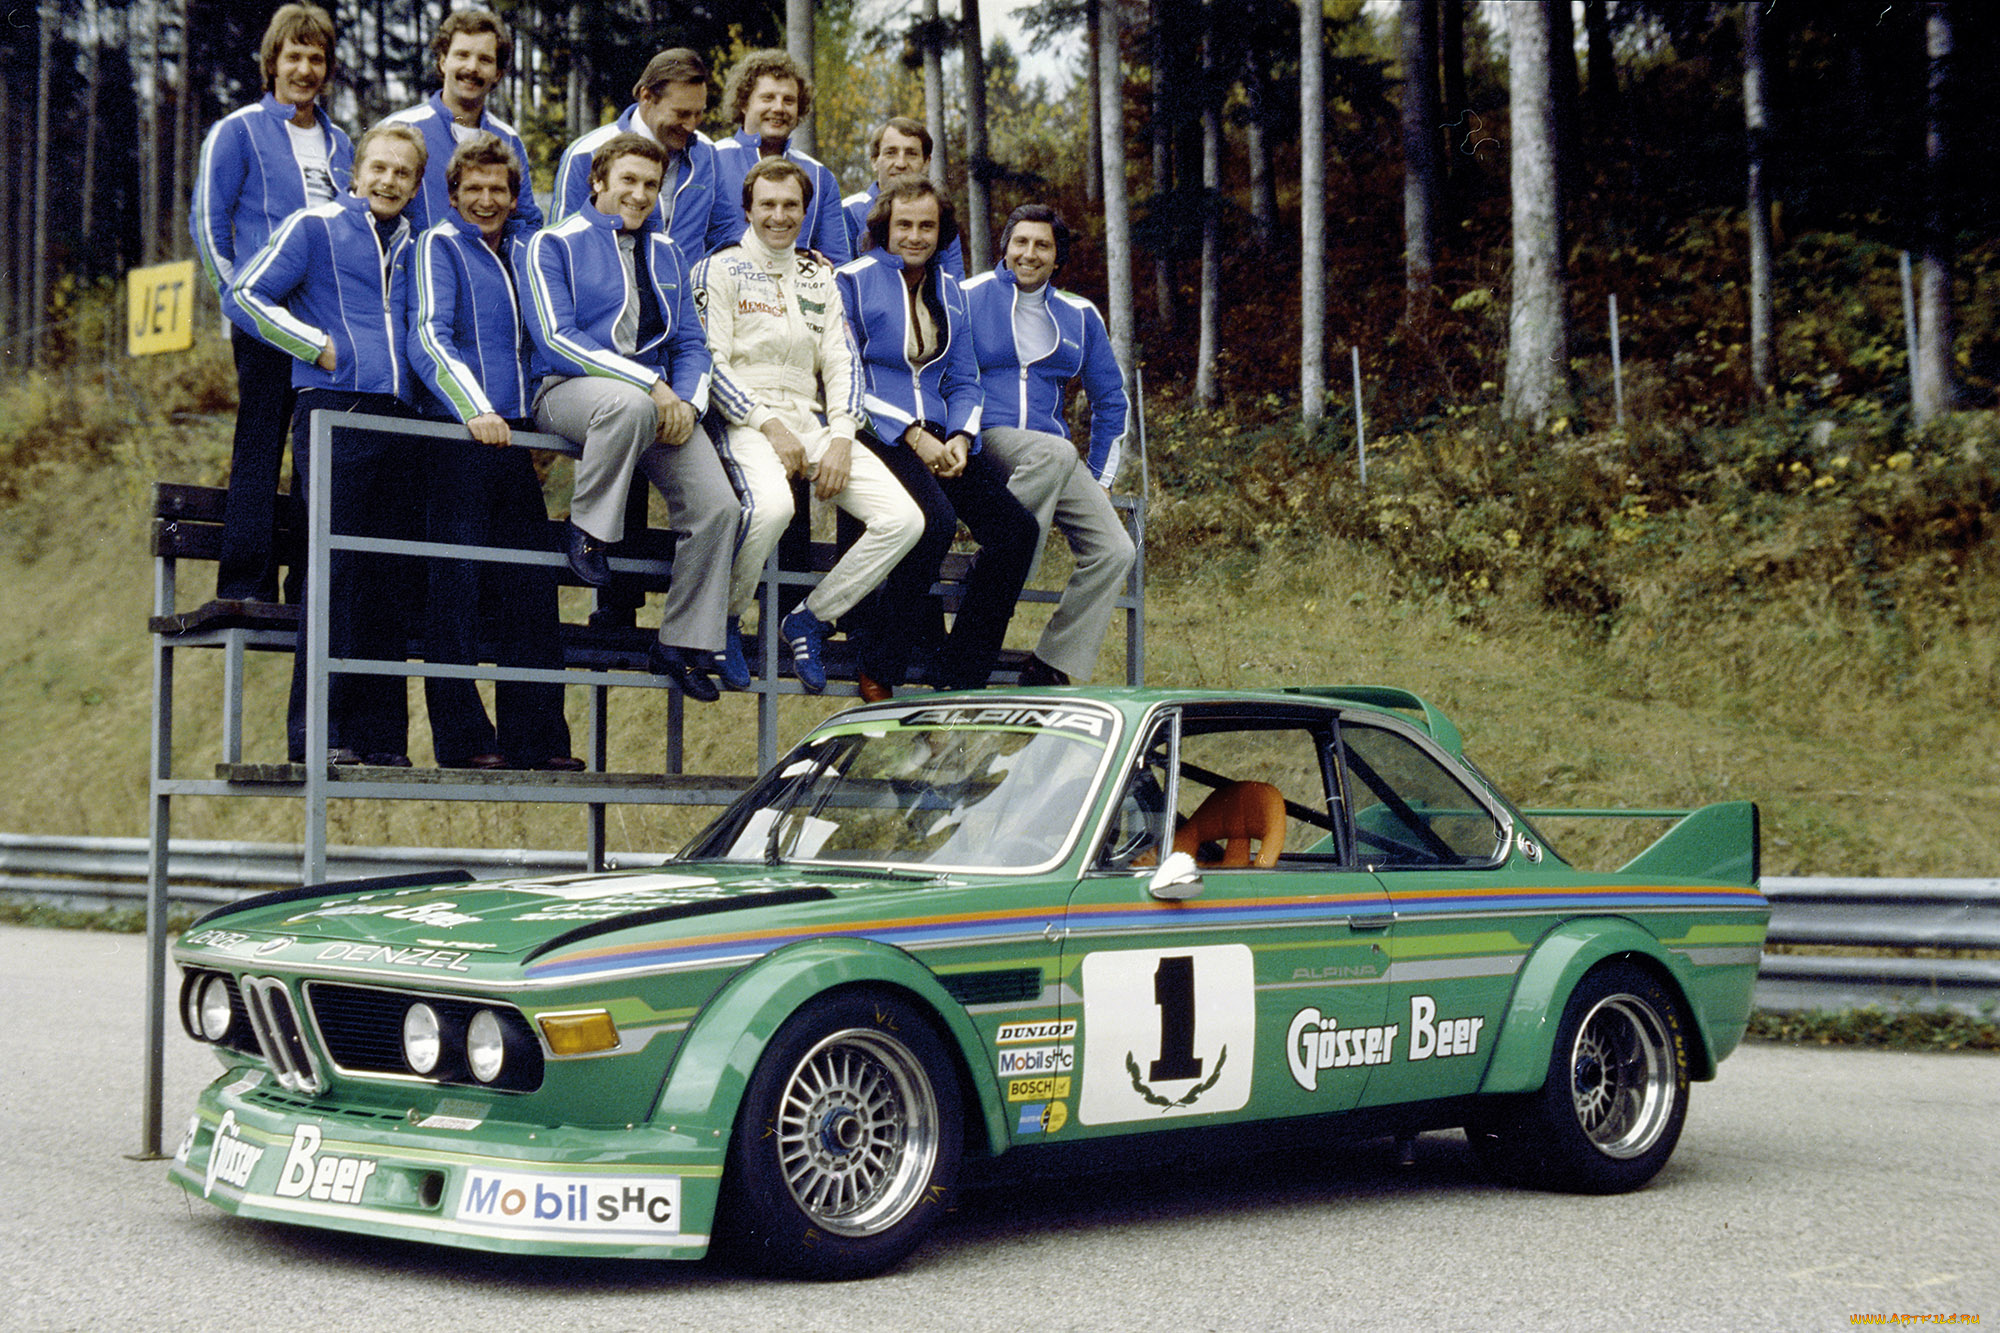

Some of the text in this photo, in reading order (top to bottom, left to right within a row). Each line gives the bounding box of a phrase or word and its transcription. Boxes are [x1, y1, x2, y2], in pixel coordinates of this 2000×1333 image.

[135, 281, 184, 337] JET
[907, 709, 1104, 737] ALPINA
[315, 944, 471, 972] DENZEL
[1292, 965, 1378, 979] ALPINA
[1000, 1024, 1074, 1040] DUNLOP
[1149, 955, 1203, 1083] 1
[1287, 994, 1485, 1092] Gösser Beer
[1000, 1050, 1044, 1072] Mobil
[1011, 1080, 1053, 1096] BOSCH
[275, 1123, 378, 1205] Beer
[465, 1177, 588, 1222] Mobil
